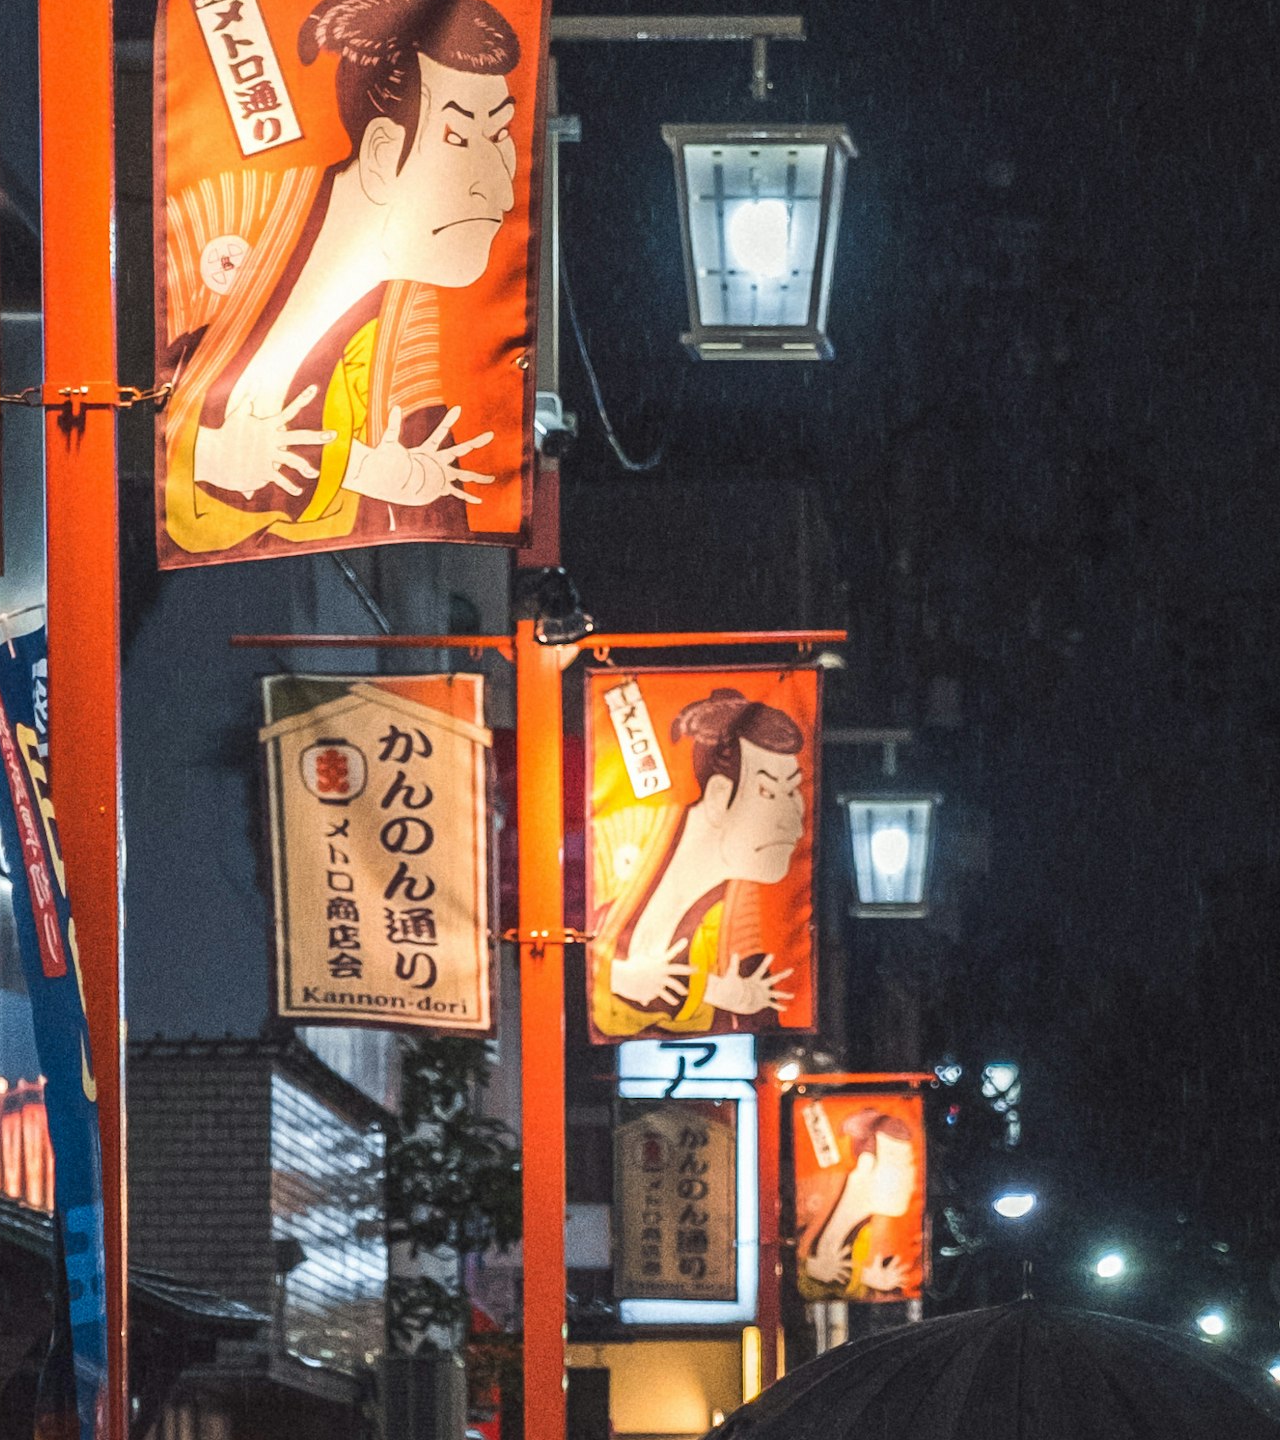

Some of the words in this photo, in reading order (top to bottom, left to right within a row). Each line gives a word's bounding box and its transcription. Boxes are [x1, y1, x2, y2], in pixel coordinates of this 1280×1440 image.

[324, 818, 364, 981] メトロ商店会
[378, 723, 438, 991] かんのん通り
[302, 984, 470, 1017] Kannon-dori
[660, 1042, 718, 1098] ア
